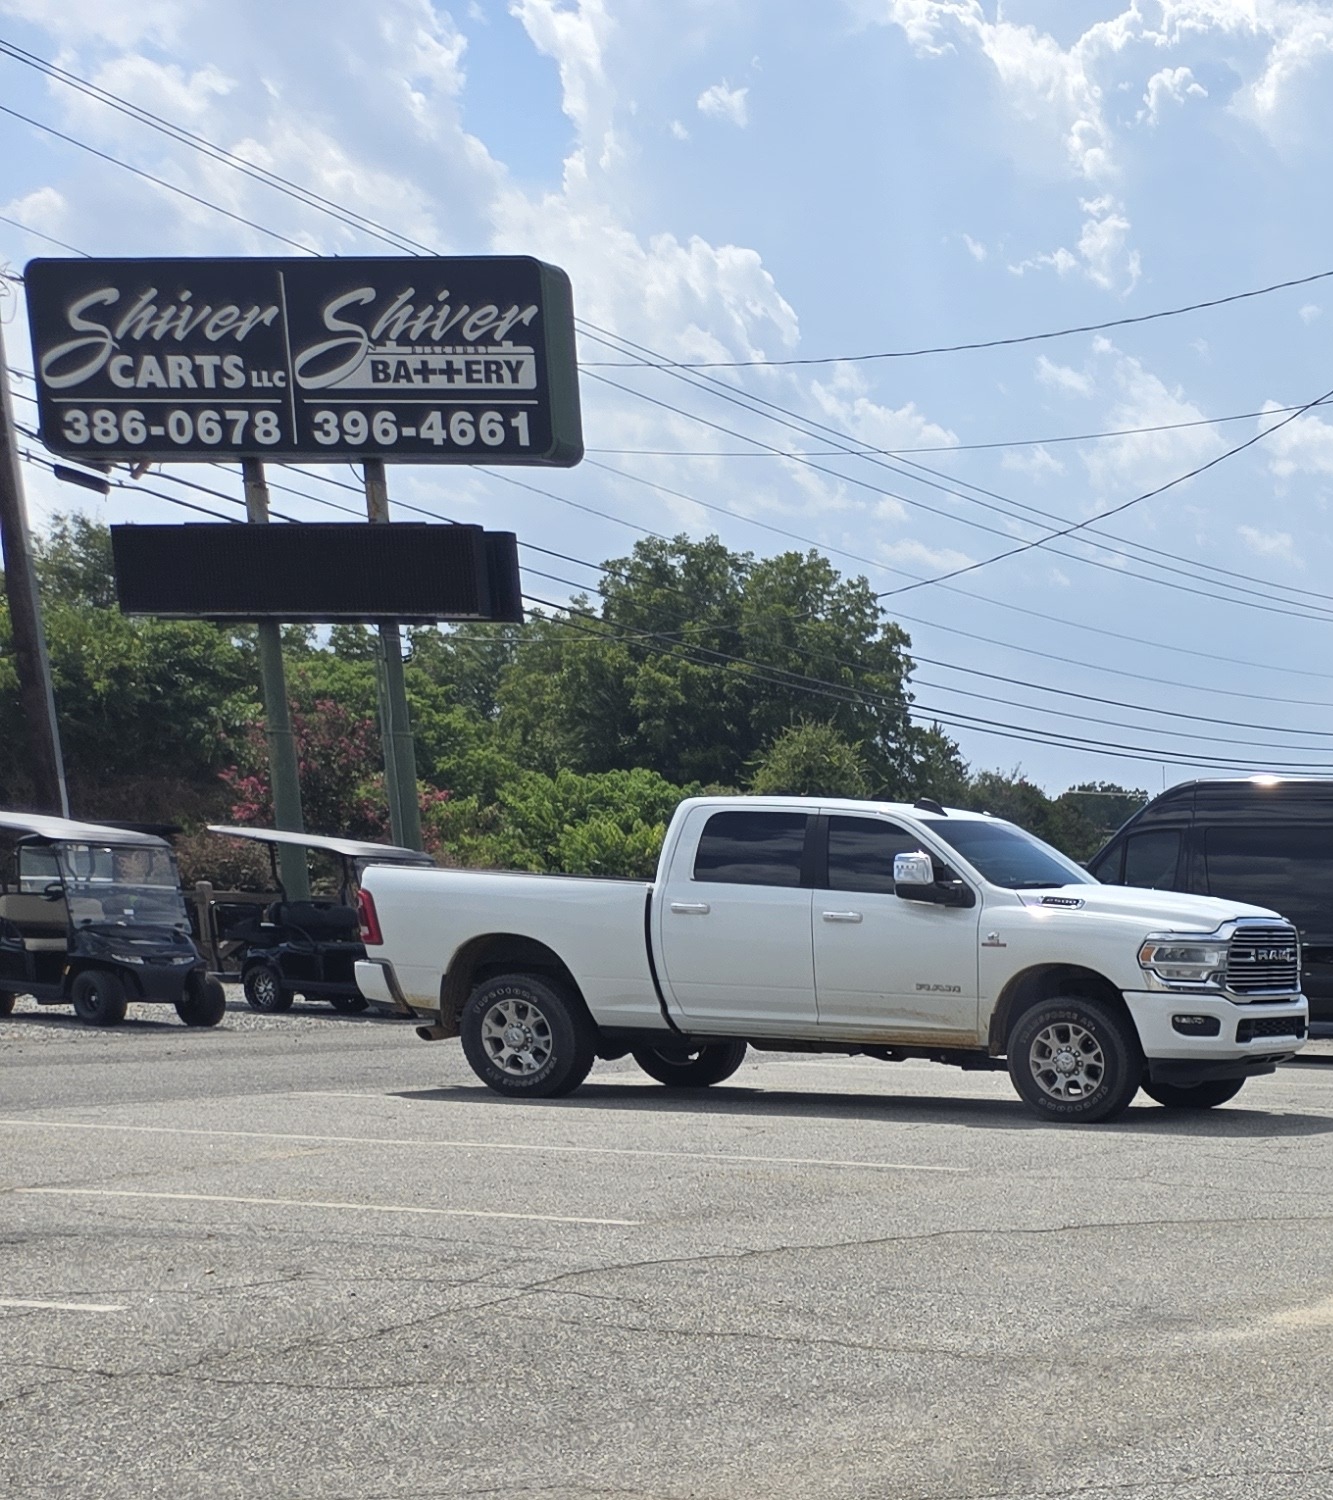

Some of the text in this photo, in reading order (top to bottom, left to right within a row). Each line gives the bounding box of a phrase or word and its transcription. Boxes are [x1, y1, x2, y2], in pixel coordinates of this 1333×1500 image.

[41, 287, 279, 389] Shiver
[295, 287, 538, 390] Shiver
[109, 354, 286, 389] CARTS LLC
[63, 409, 282, 445] 386-0678
[313, 410, 530, 446] 396-4661
